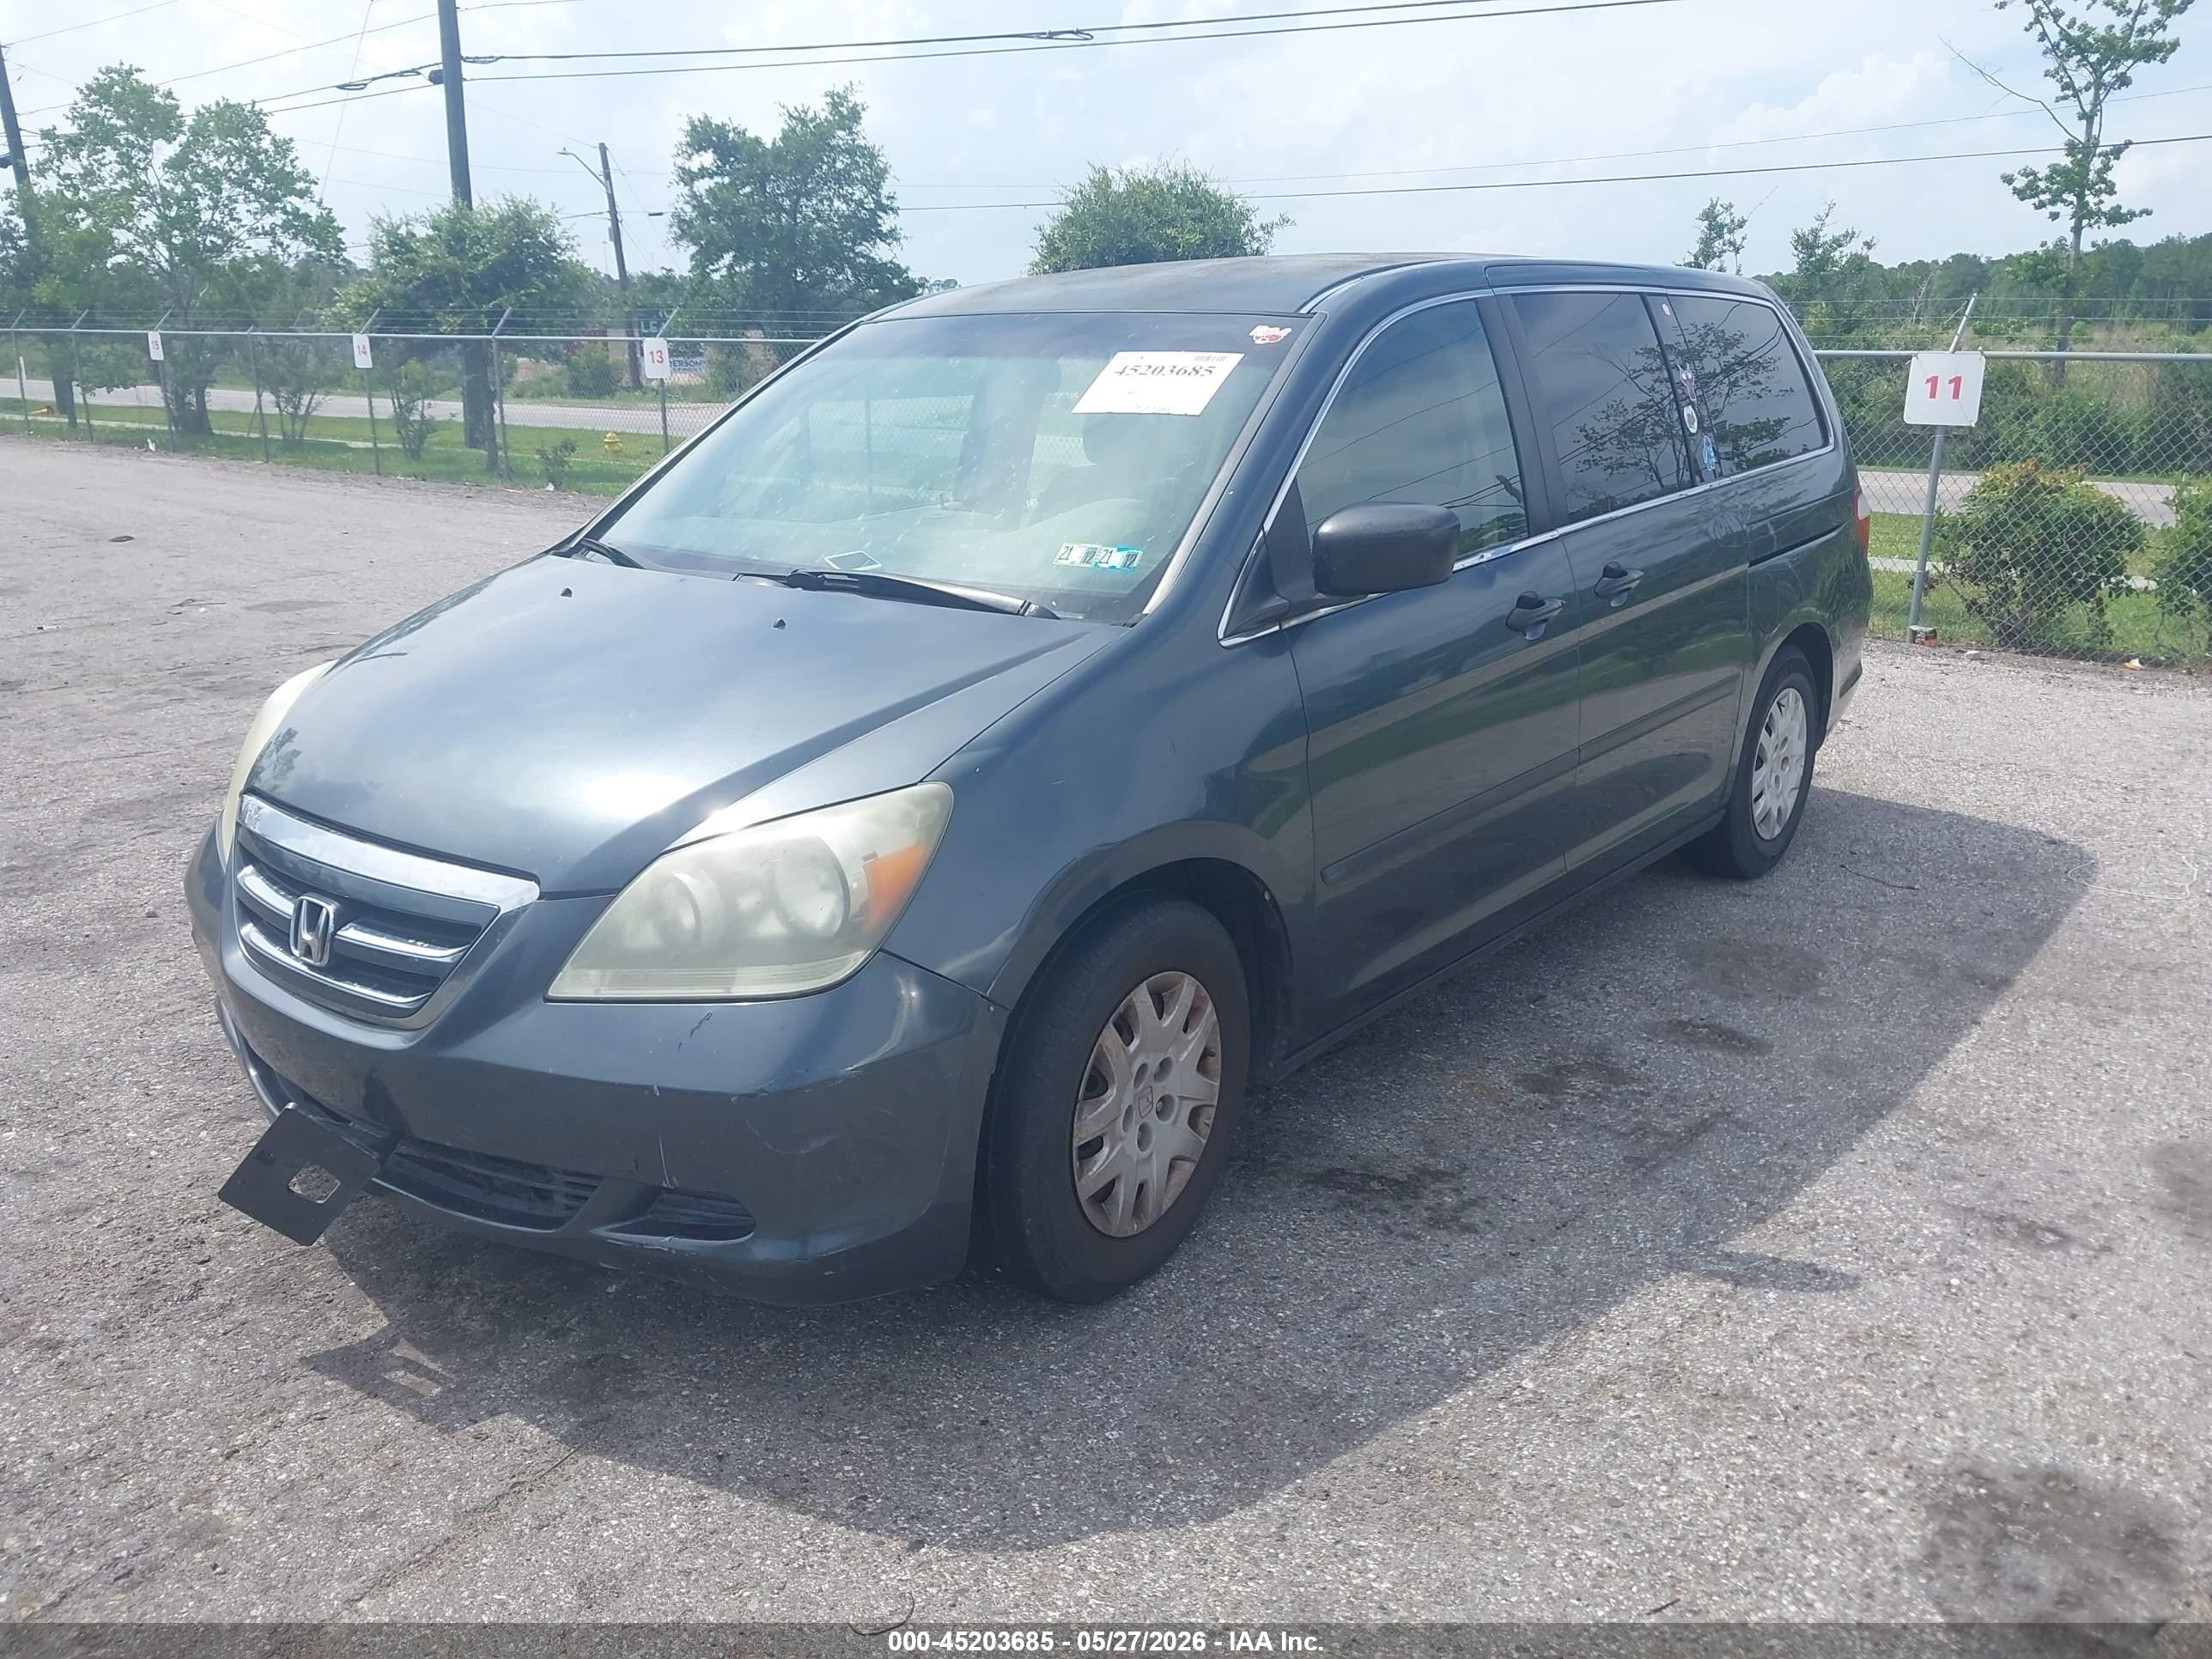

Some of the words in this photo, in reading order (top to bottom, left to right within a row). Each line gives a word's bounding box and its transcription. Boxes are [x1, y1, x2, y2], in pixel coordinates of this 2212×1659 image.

[150, 340, 160, 349] 15
[357, 344, 367, 356] 14
[649, 349, 665, 364] 13
[1115, 364, 1217, 377] 45203685
[1924, 375, 1963, 400] 11
